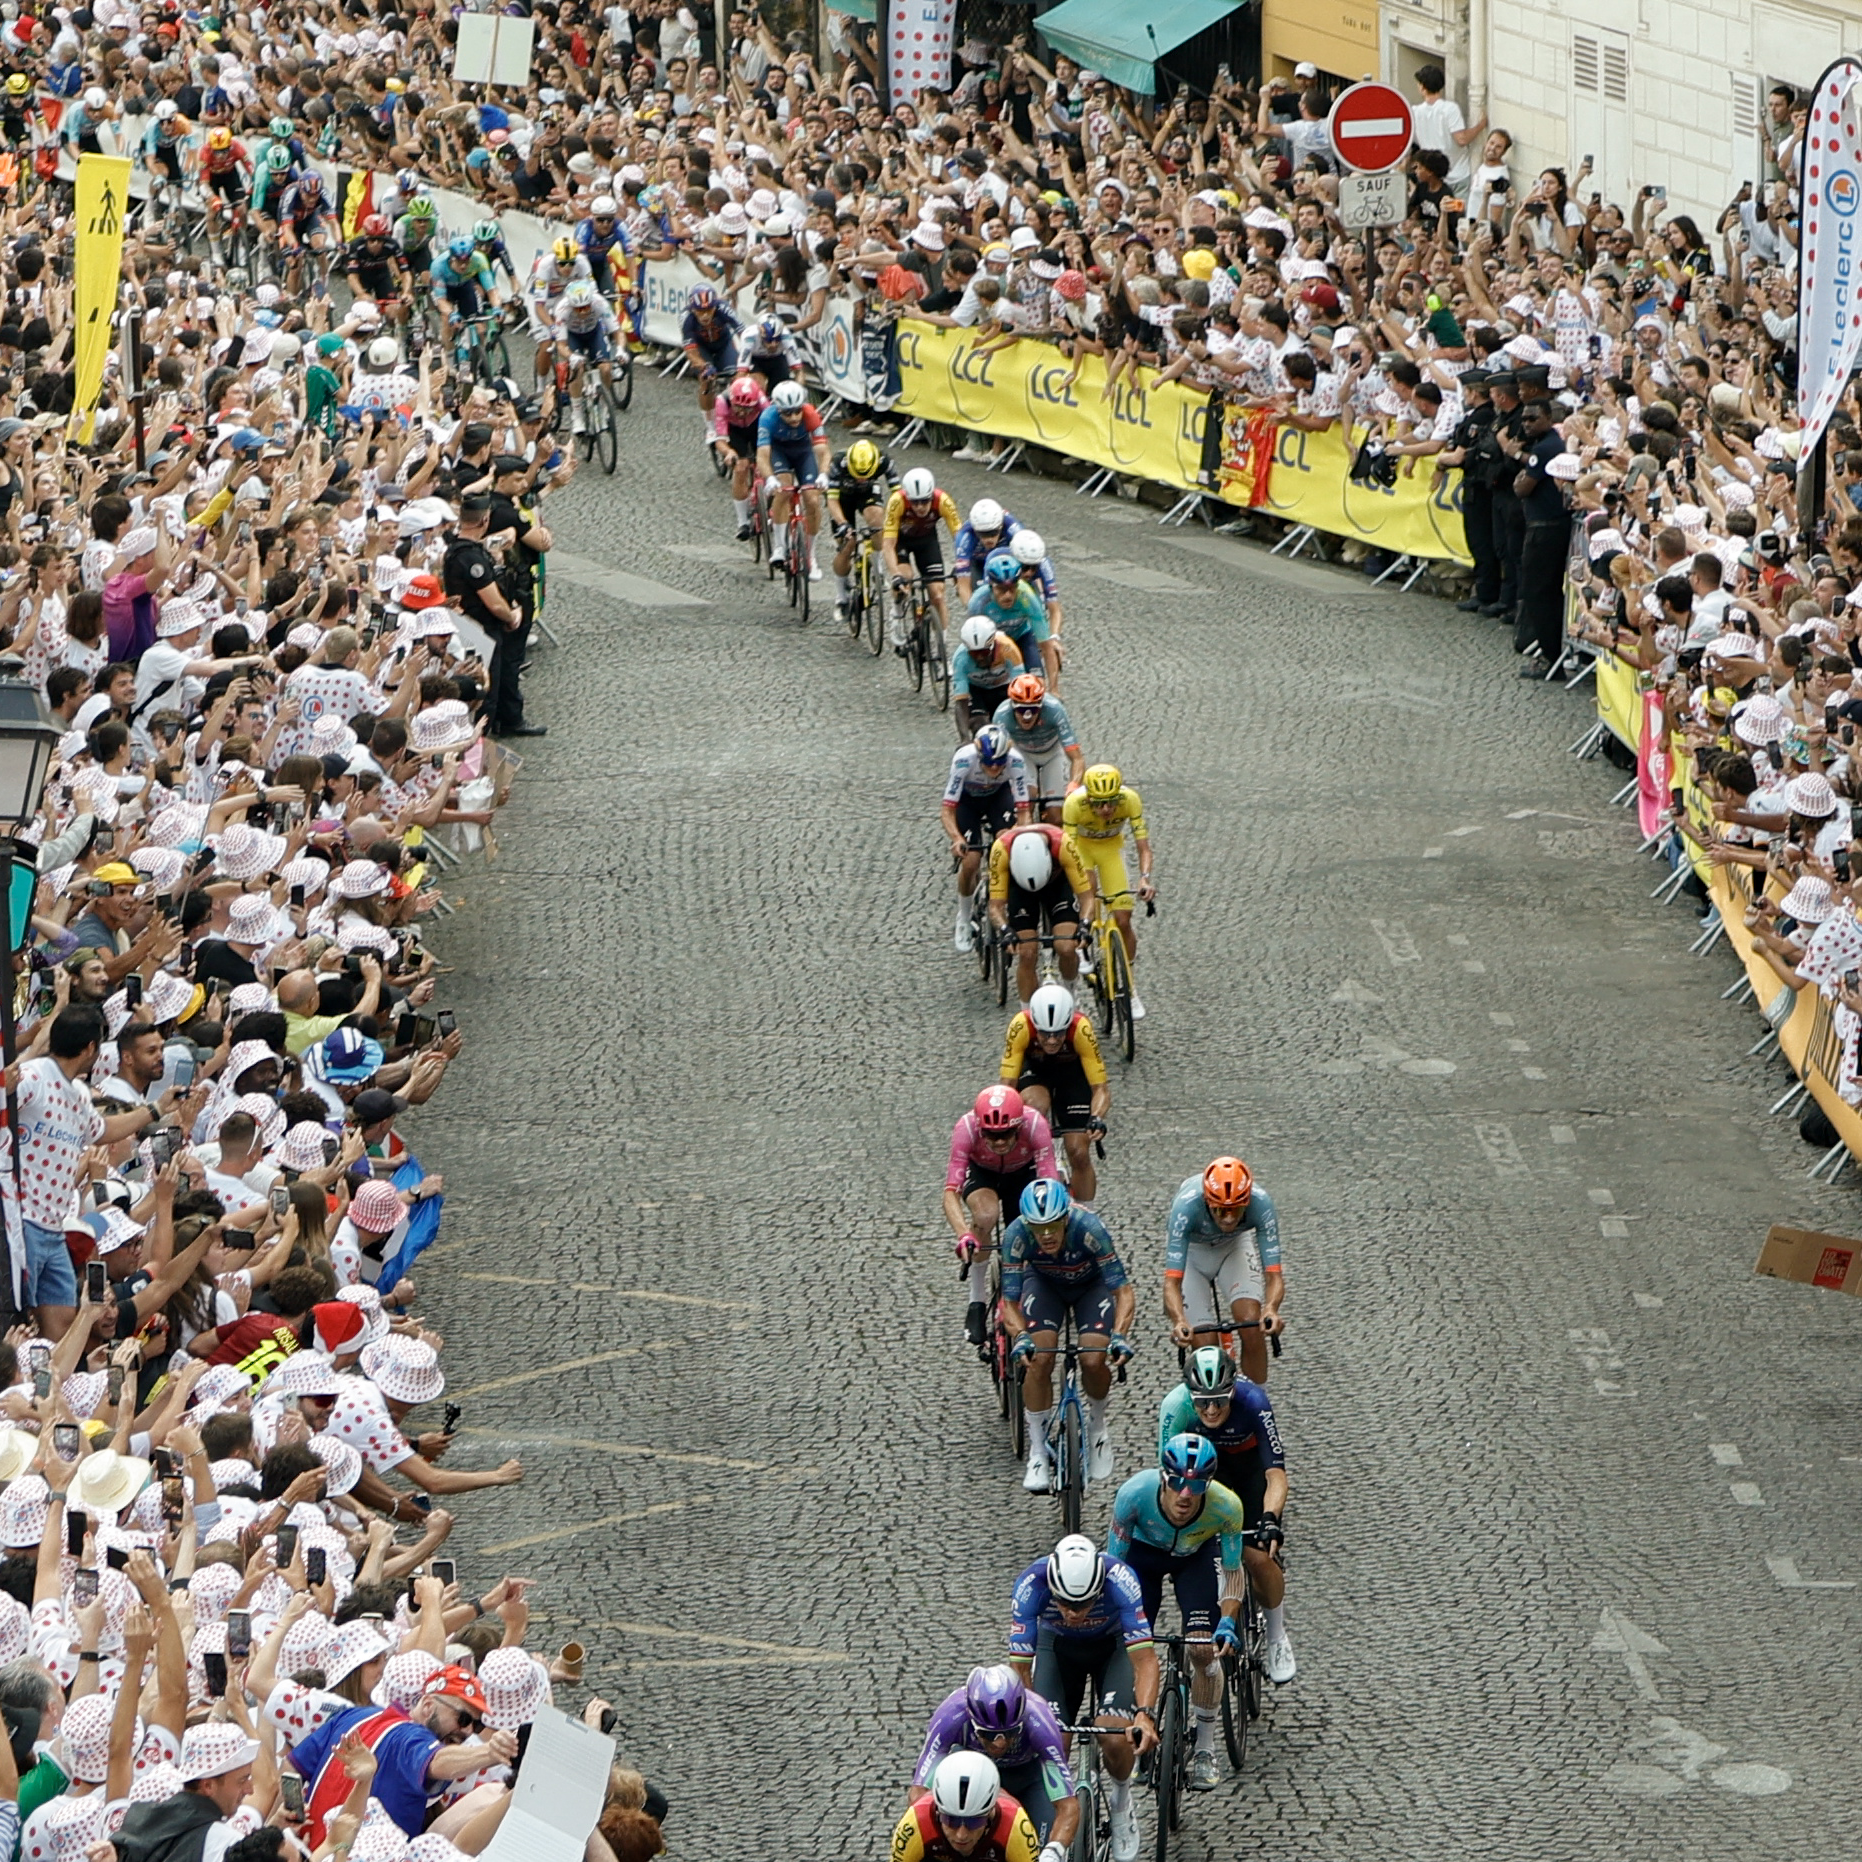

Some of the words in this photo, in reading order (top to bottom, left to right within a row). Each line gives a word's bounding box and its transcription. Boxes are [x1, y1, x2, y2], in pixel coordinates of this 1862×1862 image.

[1356, 178, 1391, 193] SAUF
[648, 277, 690, 314] E.Lecl
[896, 331, 923, 370] CL
[952, 344, 994, 388] LCL
[1114, 384, 1151, 429] LCL
[1182, 402, 1205, 441] LC
[1259, 1409, 1282, 1455] Adecco
[1109, 1562, 1142, 1598] Alpecin
